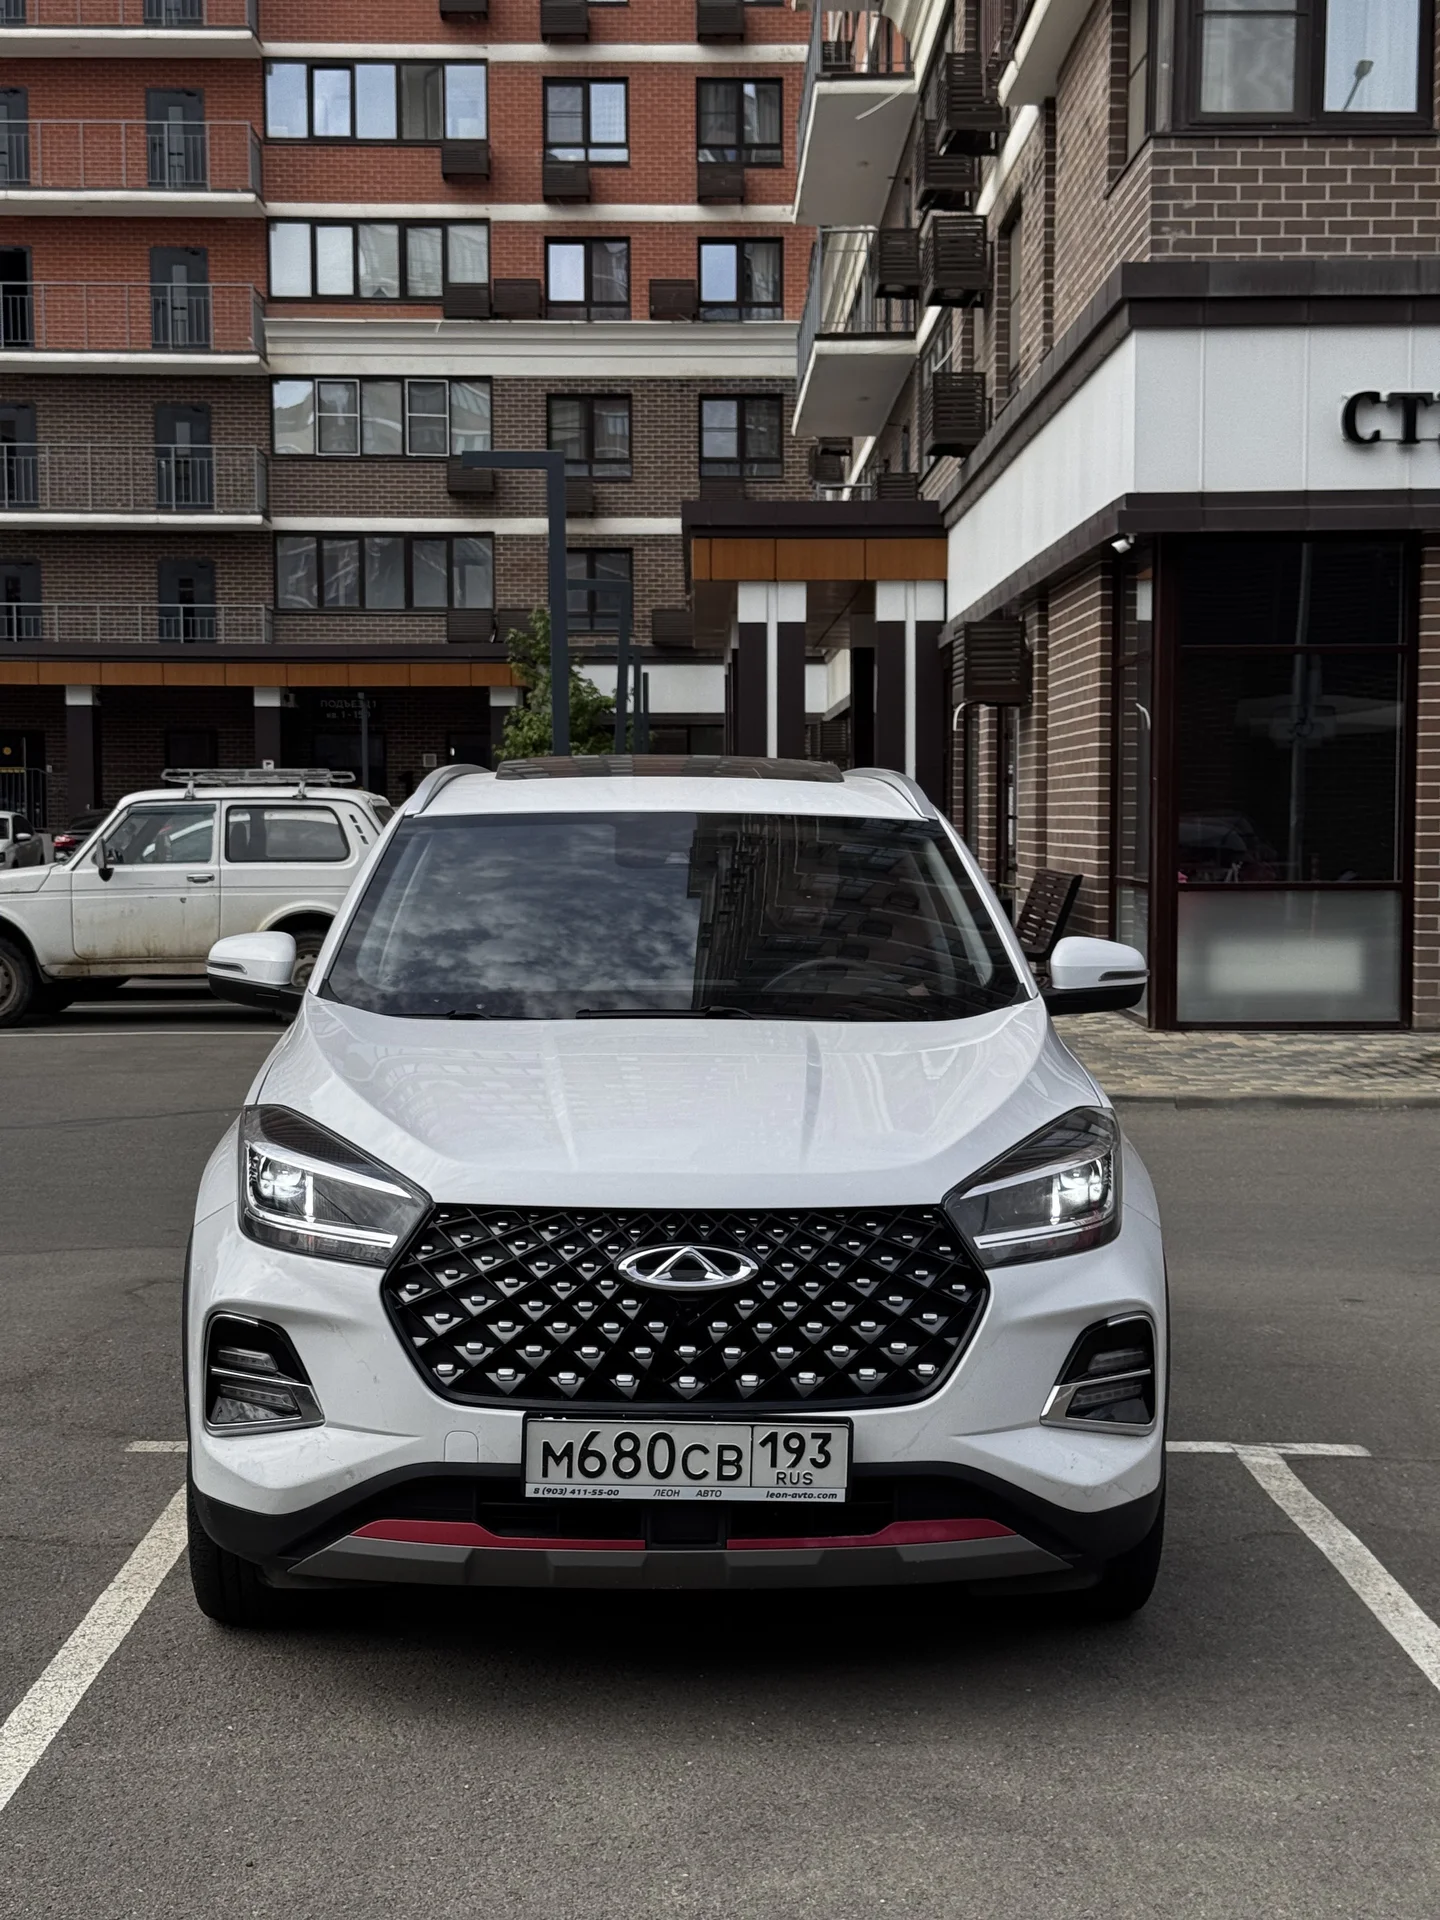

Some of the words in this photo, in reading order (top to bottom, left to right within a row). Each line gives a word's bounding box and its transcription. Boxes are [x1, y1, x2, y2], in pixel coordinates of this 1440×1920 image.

[1341, 391, 1440, 445] СТ
[541, 1429, 743, 1481] М680СВ
[758, 1431, 832, 1469] 193
[533, 1487, 540, 1495] 8
[542, 1487, 567, 1496] (903)
[569, 1488, 620, 1496] 411-55-00
[653, 1489, 681, 1497] ЛЕОН
[695, 1489, 722, 1498] АВТО
[765, 1491, 838, 1499] leon-avto.com
[776, 1471, 813, 1486] RUS
